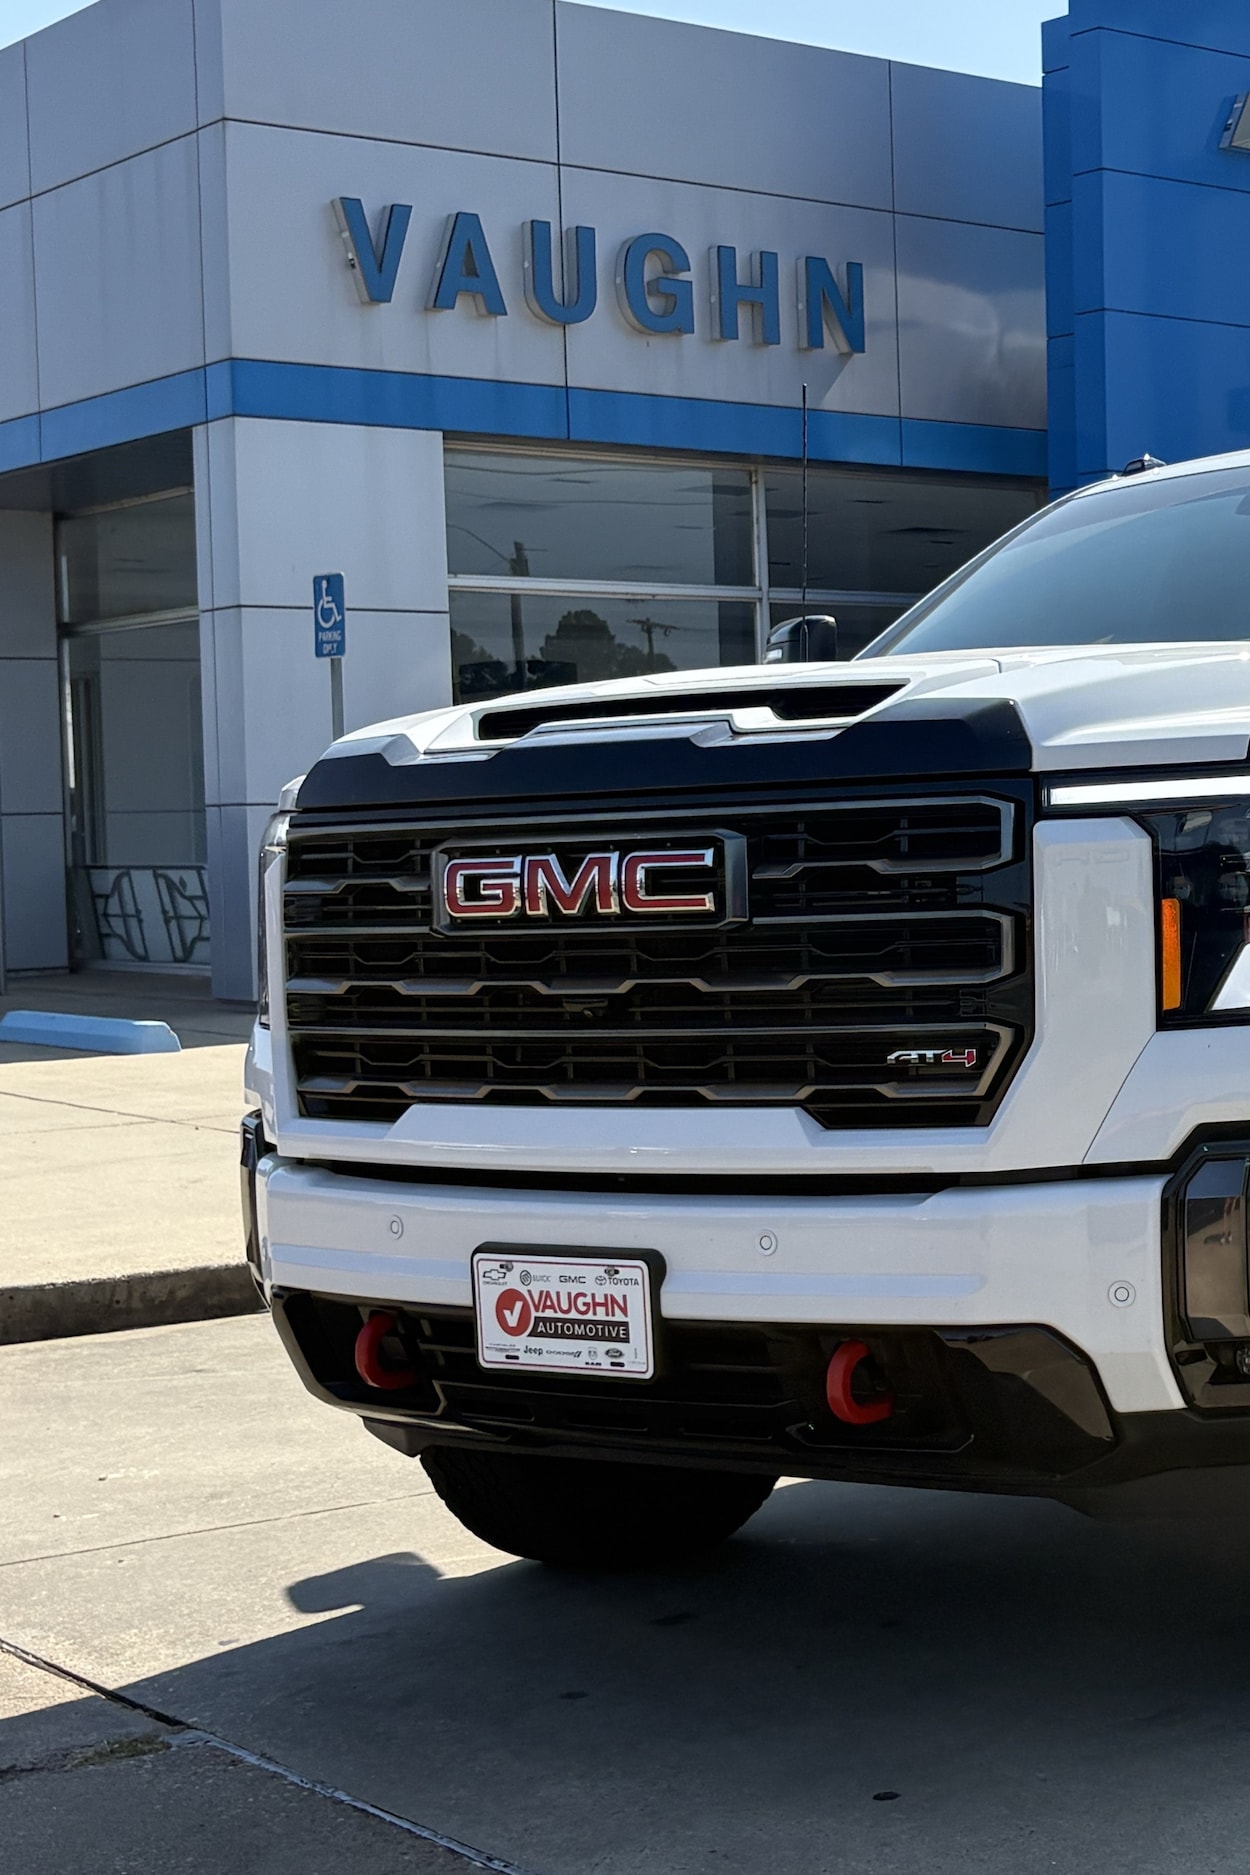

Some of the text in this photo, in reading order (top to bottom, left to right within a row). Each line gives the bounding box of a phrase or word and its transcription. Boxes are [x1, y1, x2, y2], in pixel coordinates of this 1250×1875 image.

[335, 197, 866, 354] VAUGHN
[444, 848, 715, 917] GMC
[887, 1049, 976, 1067] AT4
[559, 1275, 587, 1284] GMC
[608, 1276, 640, 1286] TOYOTA
[527, 1289, 629, 1318] VAUGHN
[537, 1322, 627, 1338] AUTOMOTIVE
[523, 1345, 543, 1356] Jeep
